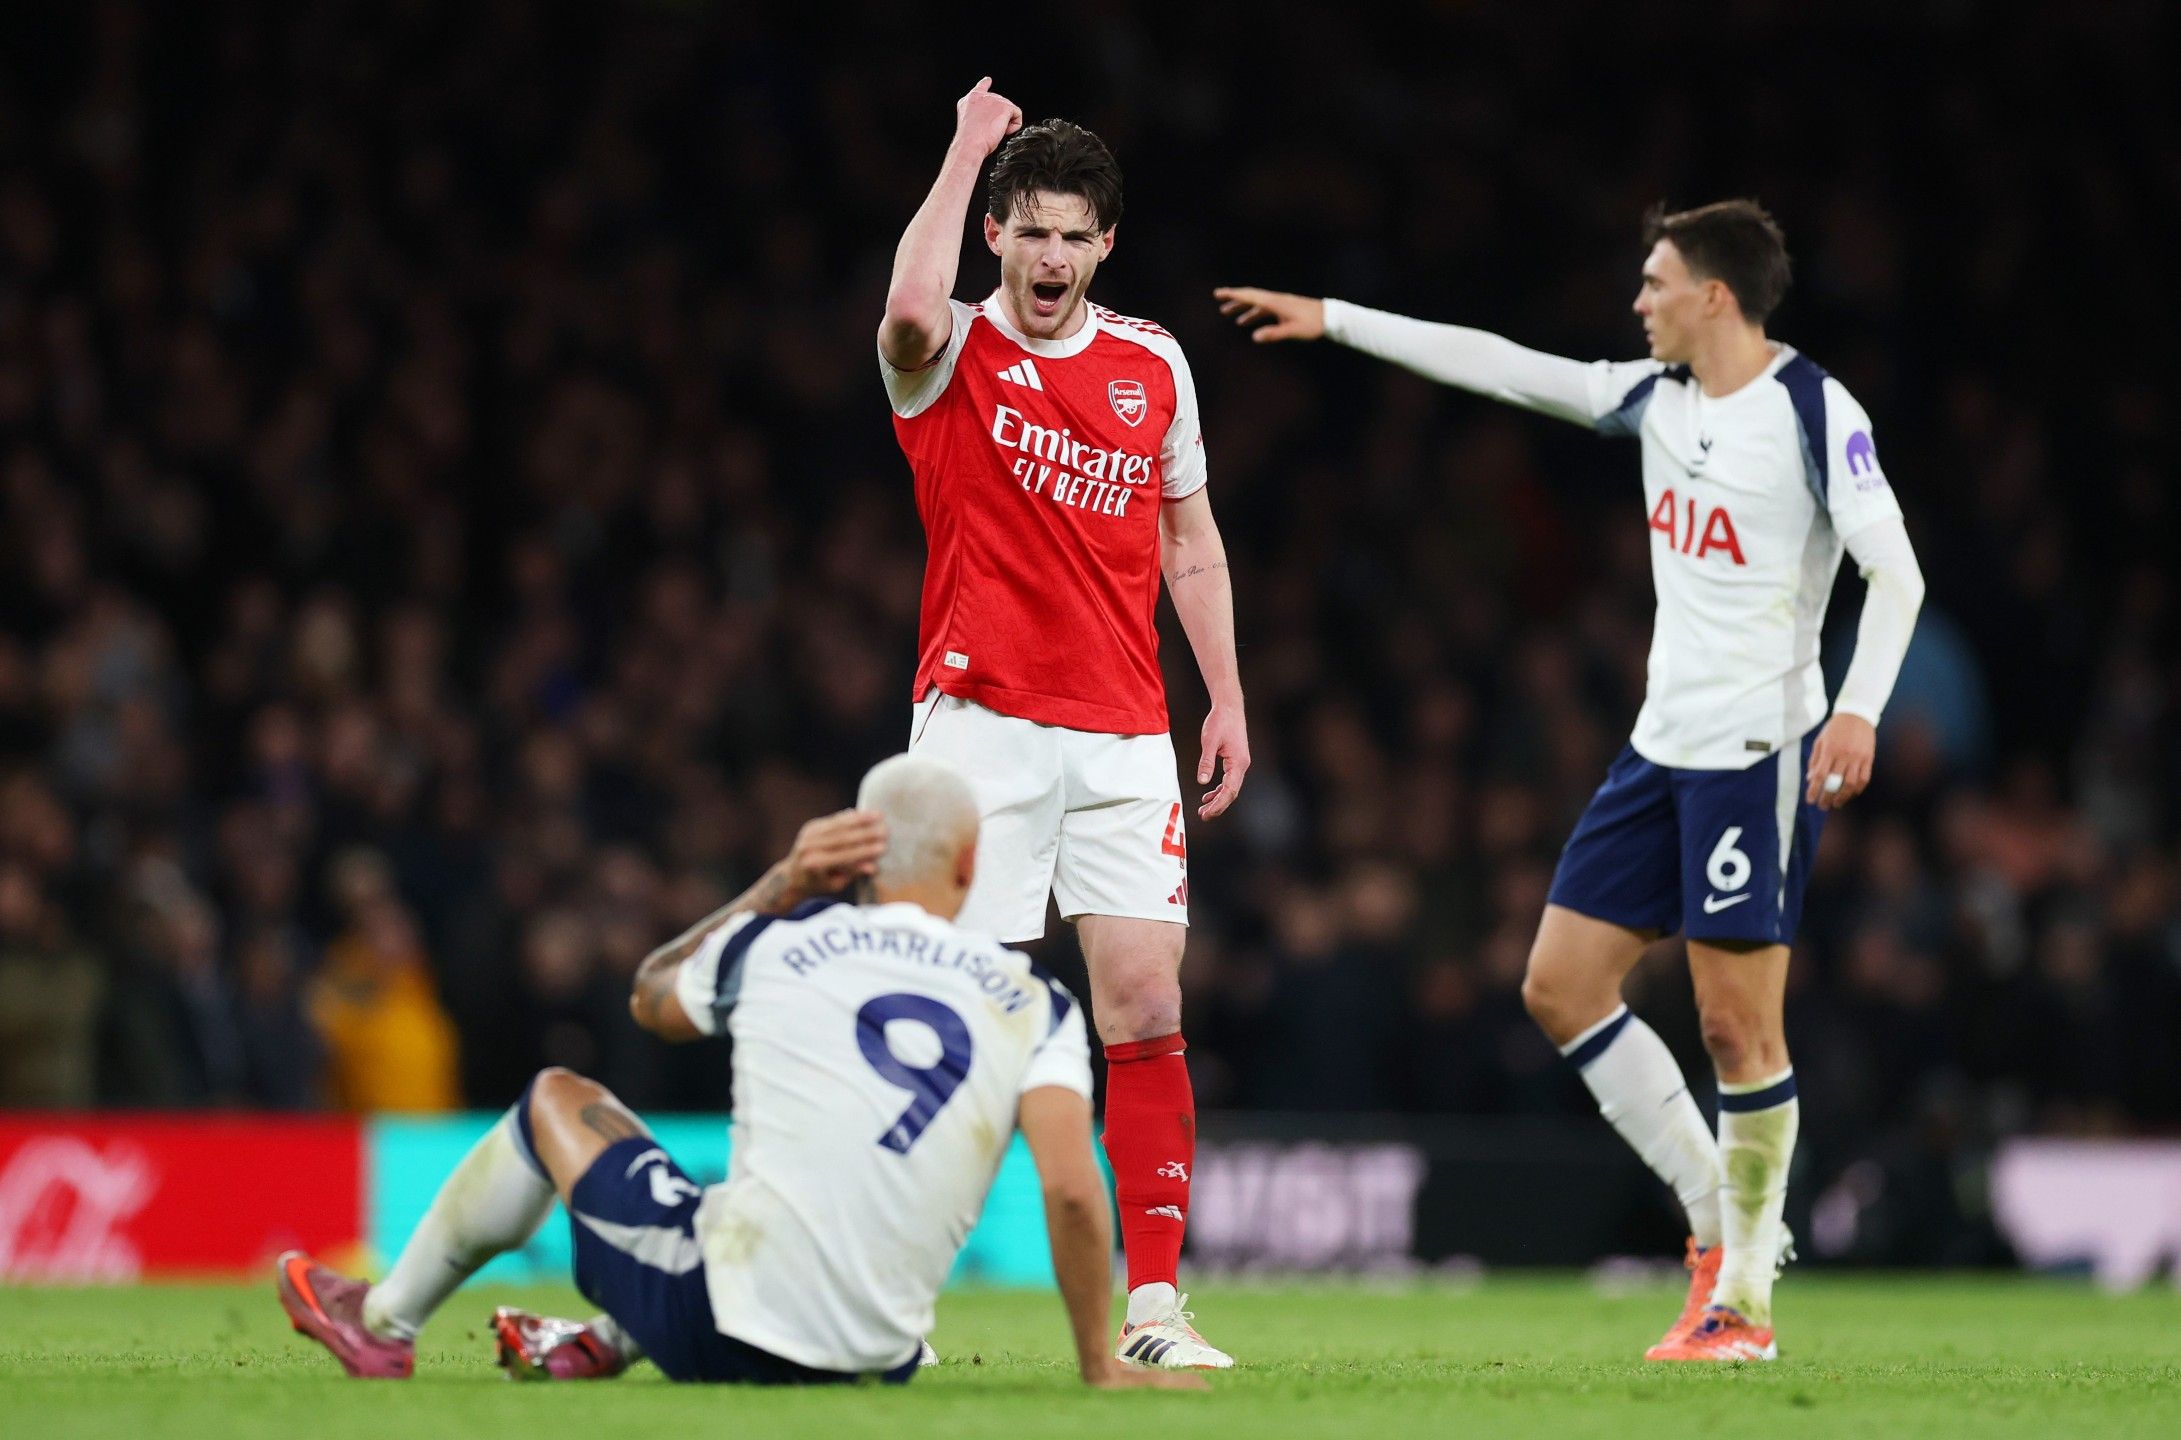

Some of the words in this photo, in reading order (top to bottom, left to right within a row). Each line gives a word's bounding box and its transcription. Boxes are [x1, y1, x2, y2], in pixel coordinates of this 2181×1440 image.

[1114, 387, 1141, 396] Arsenal
[992, 404, 1152, 485] Emirates
[1013, 458, 1051, 494] FLY
[1053, 471, 1132, 517] BETTER
[1649, 487, 1746, 566] AIA
[1161, 802, 1185, 869] 4
[1706, 826, 1751, 892] 6
[782, 923, 1035, 1014] RICHARLISON
[856, 993, 972, 1156] 9
